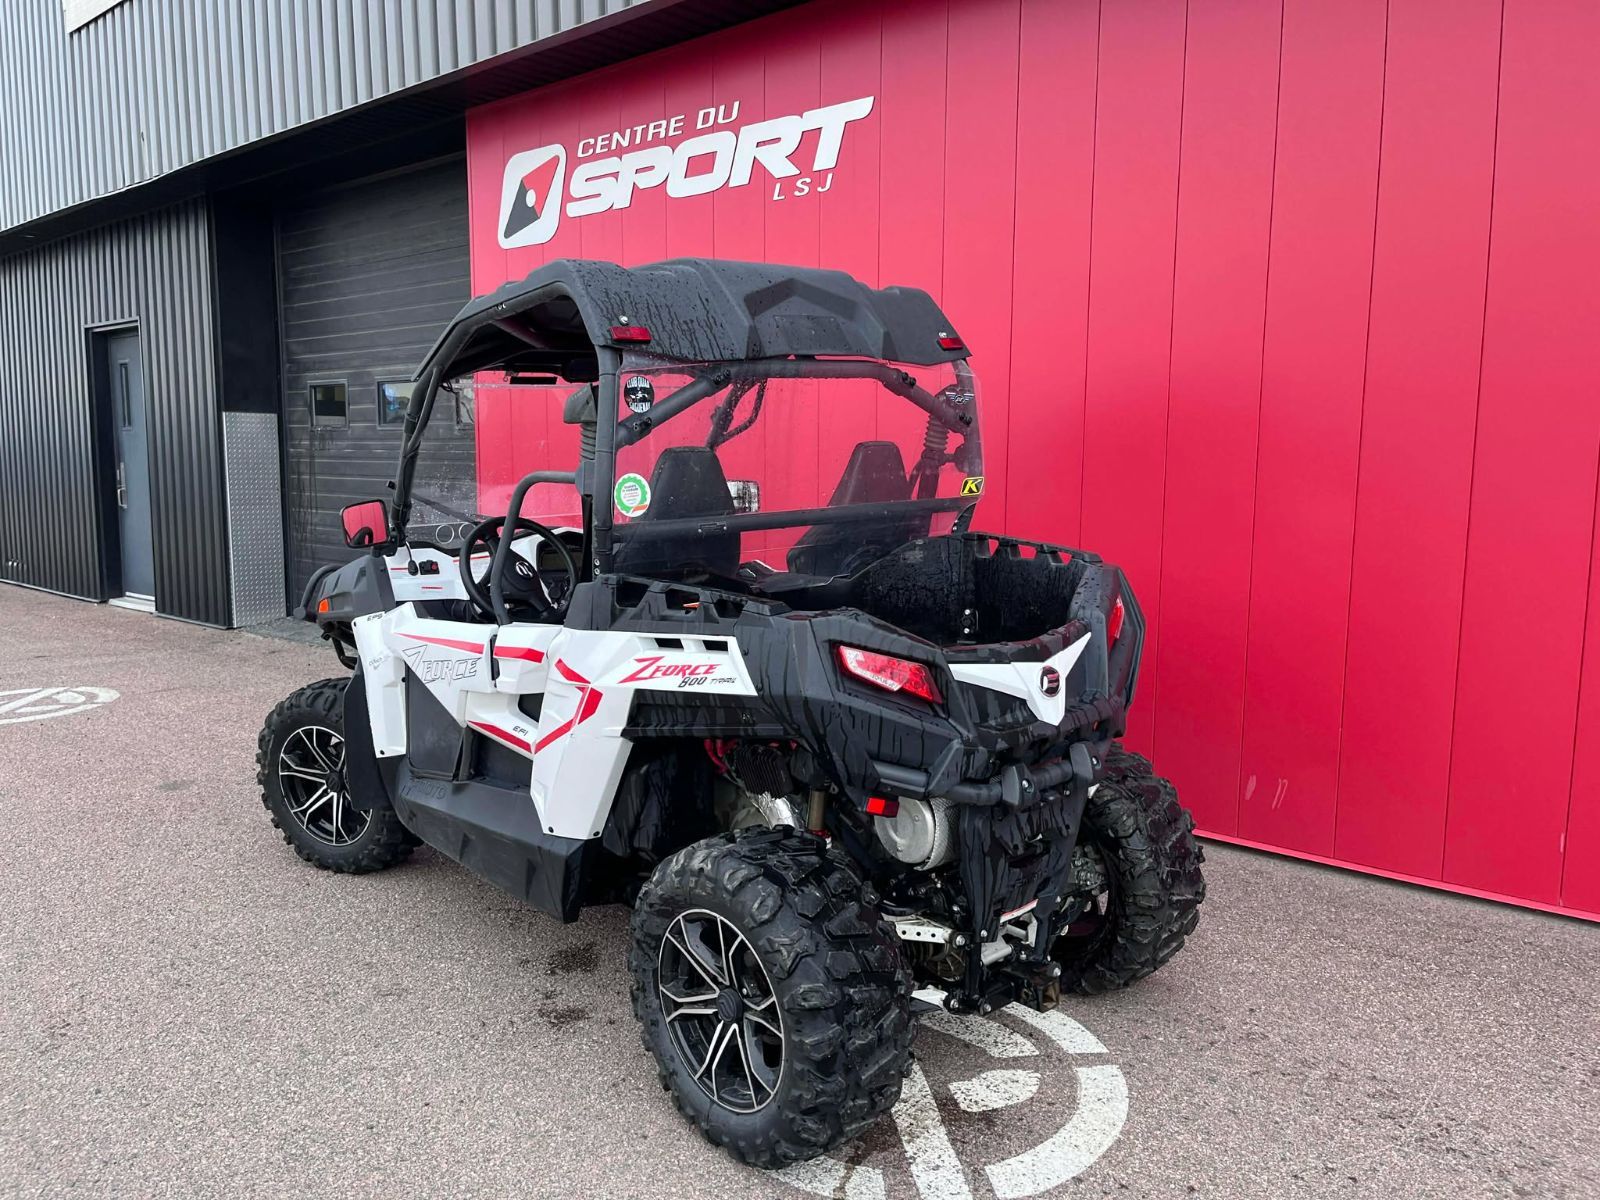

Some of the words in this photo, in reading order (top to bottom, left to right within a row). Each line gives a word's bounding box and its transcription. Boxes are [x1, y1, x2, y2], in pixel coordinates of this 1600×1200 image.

[577, 115, 686, 158] CENTRE
[696, 101, 740, 130] DU
[566, 96, 875, 218] SPORT
[678, 676, 708, 688] 800
[513, 725, 528, 737] EFI
